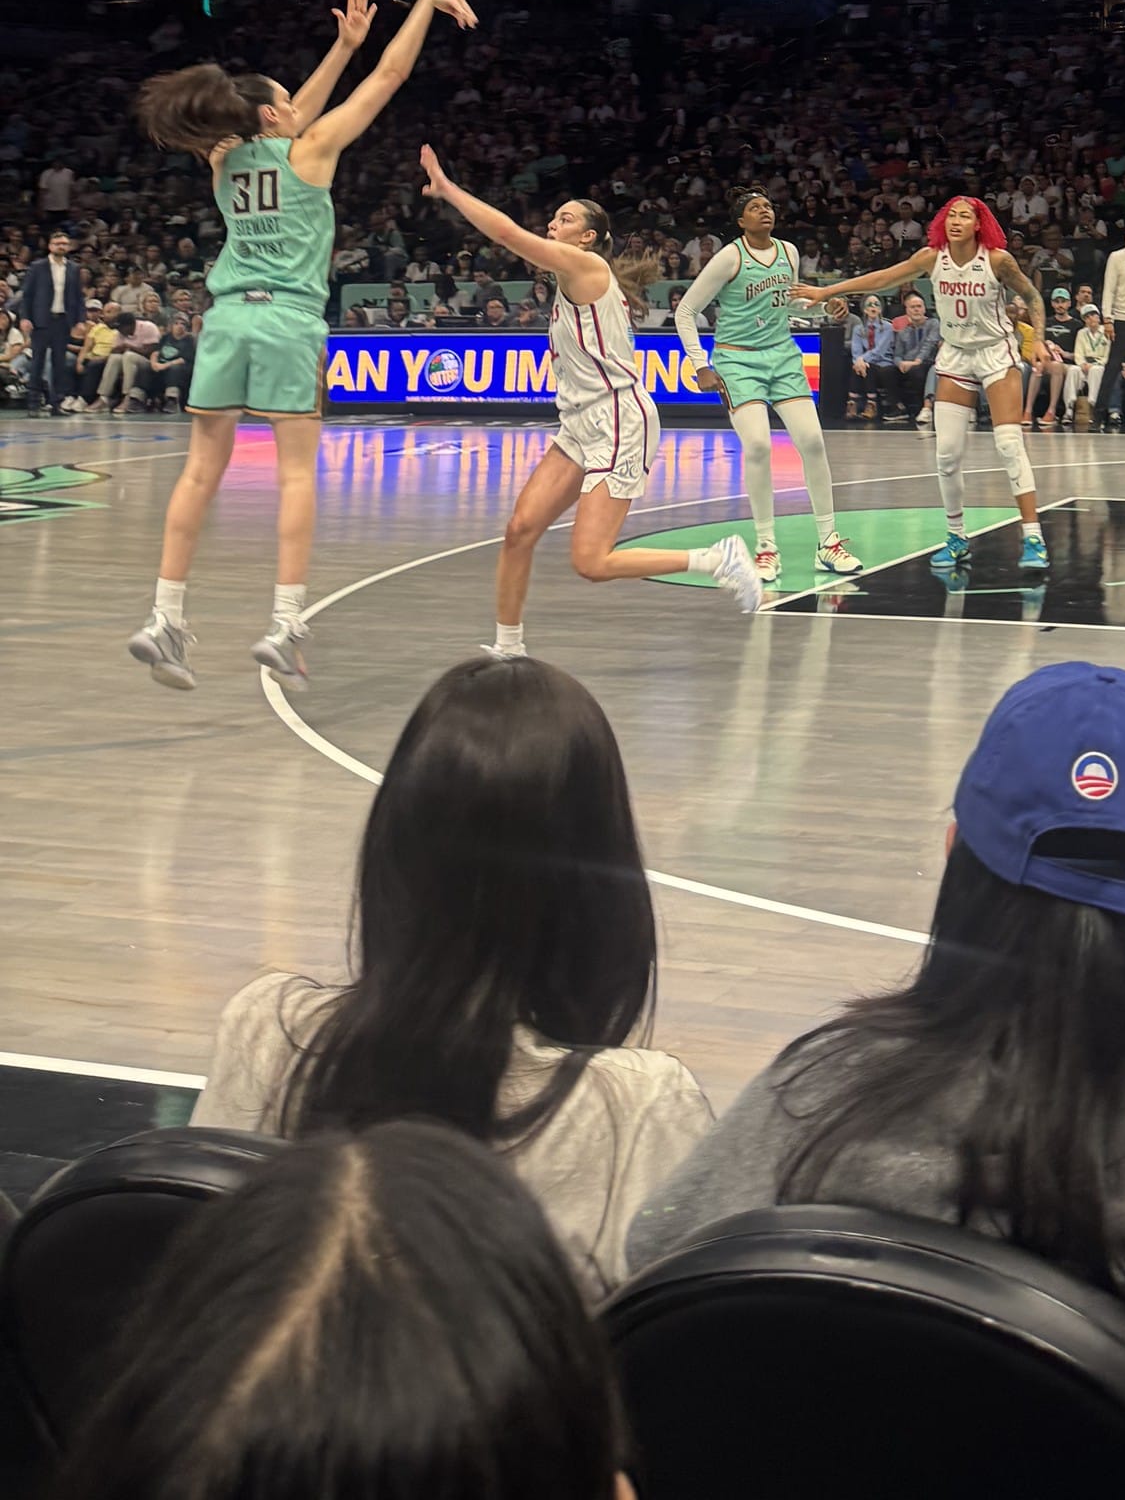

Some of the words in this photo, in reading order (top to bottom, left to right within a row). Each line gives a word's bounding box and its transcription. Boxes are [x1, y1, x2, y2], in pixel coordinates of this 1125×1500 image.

[230, 168, 280, 216] 30
[956, 299, 968, 319] 0
[327, 350, 390, 392] AN
